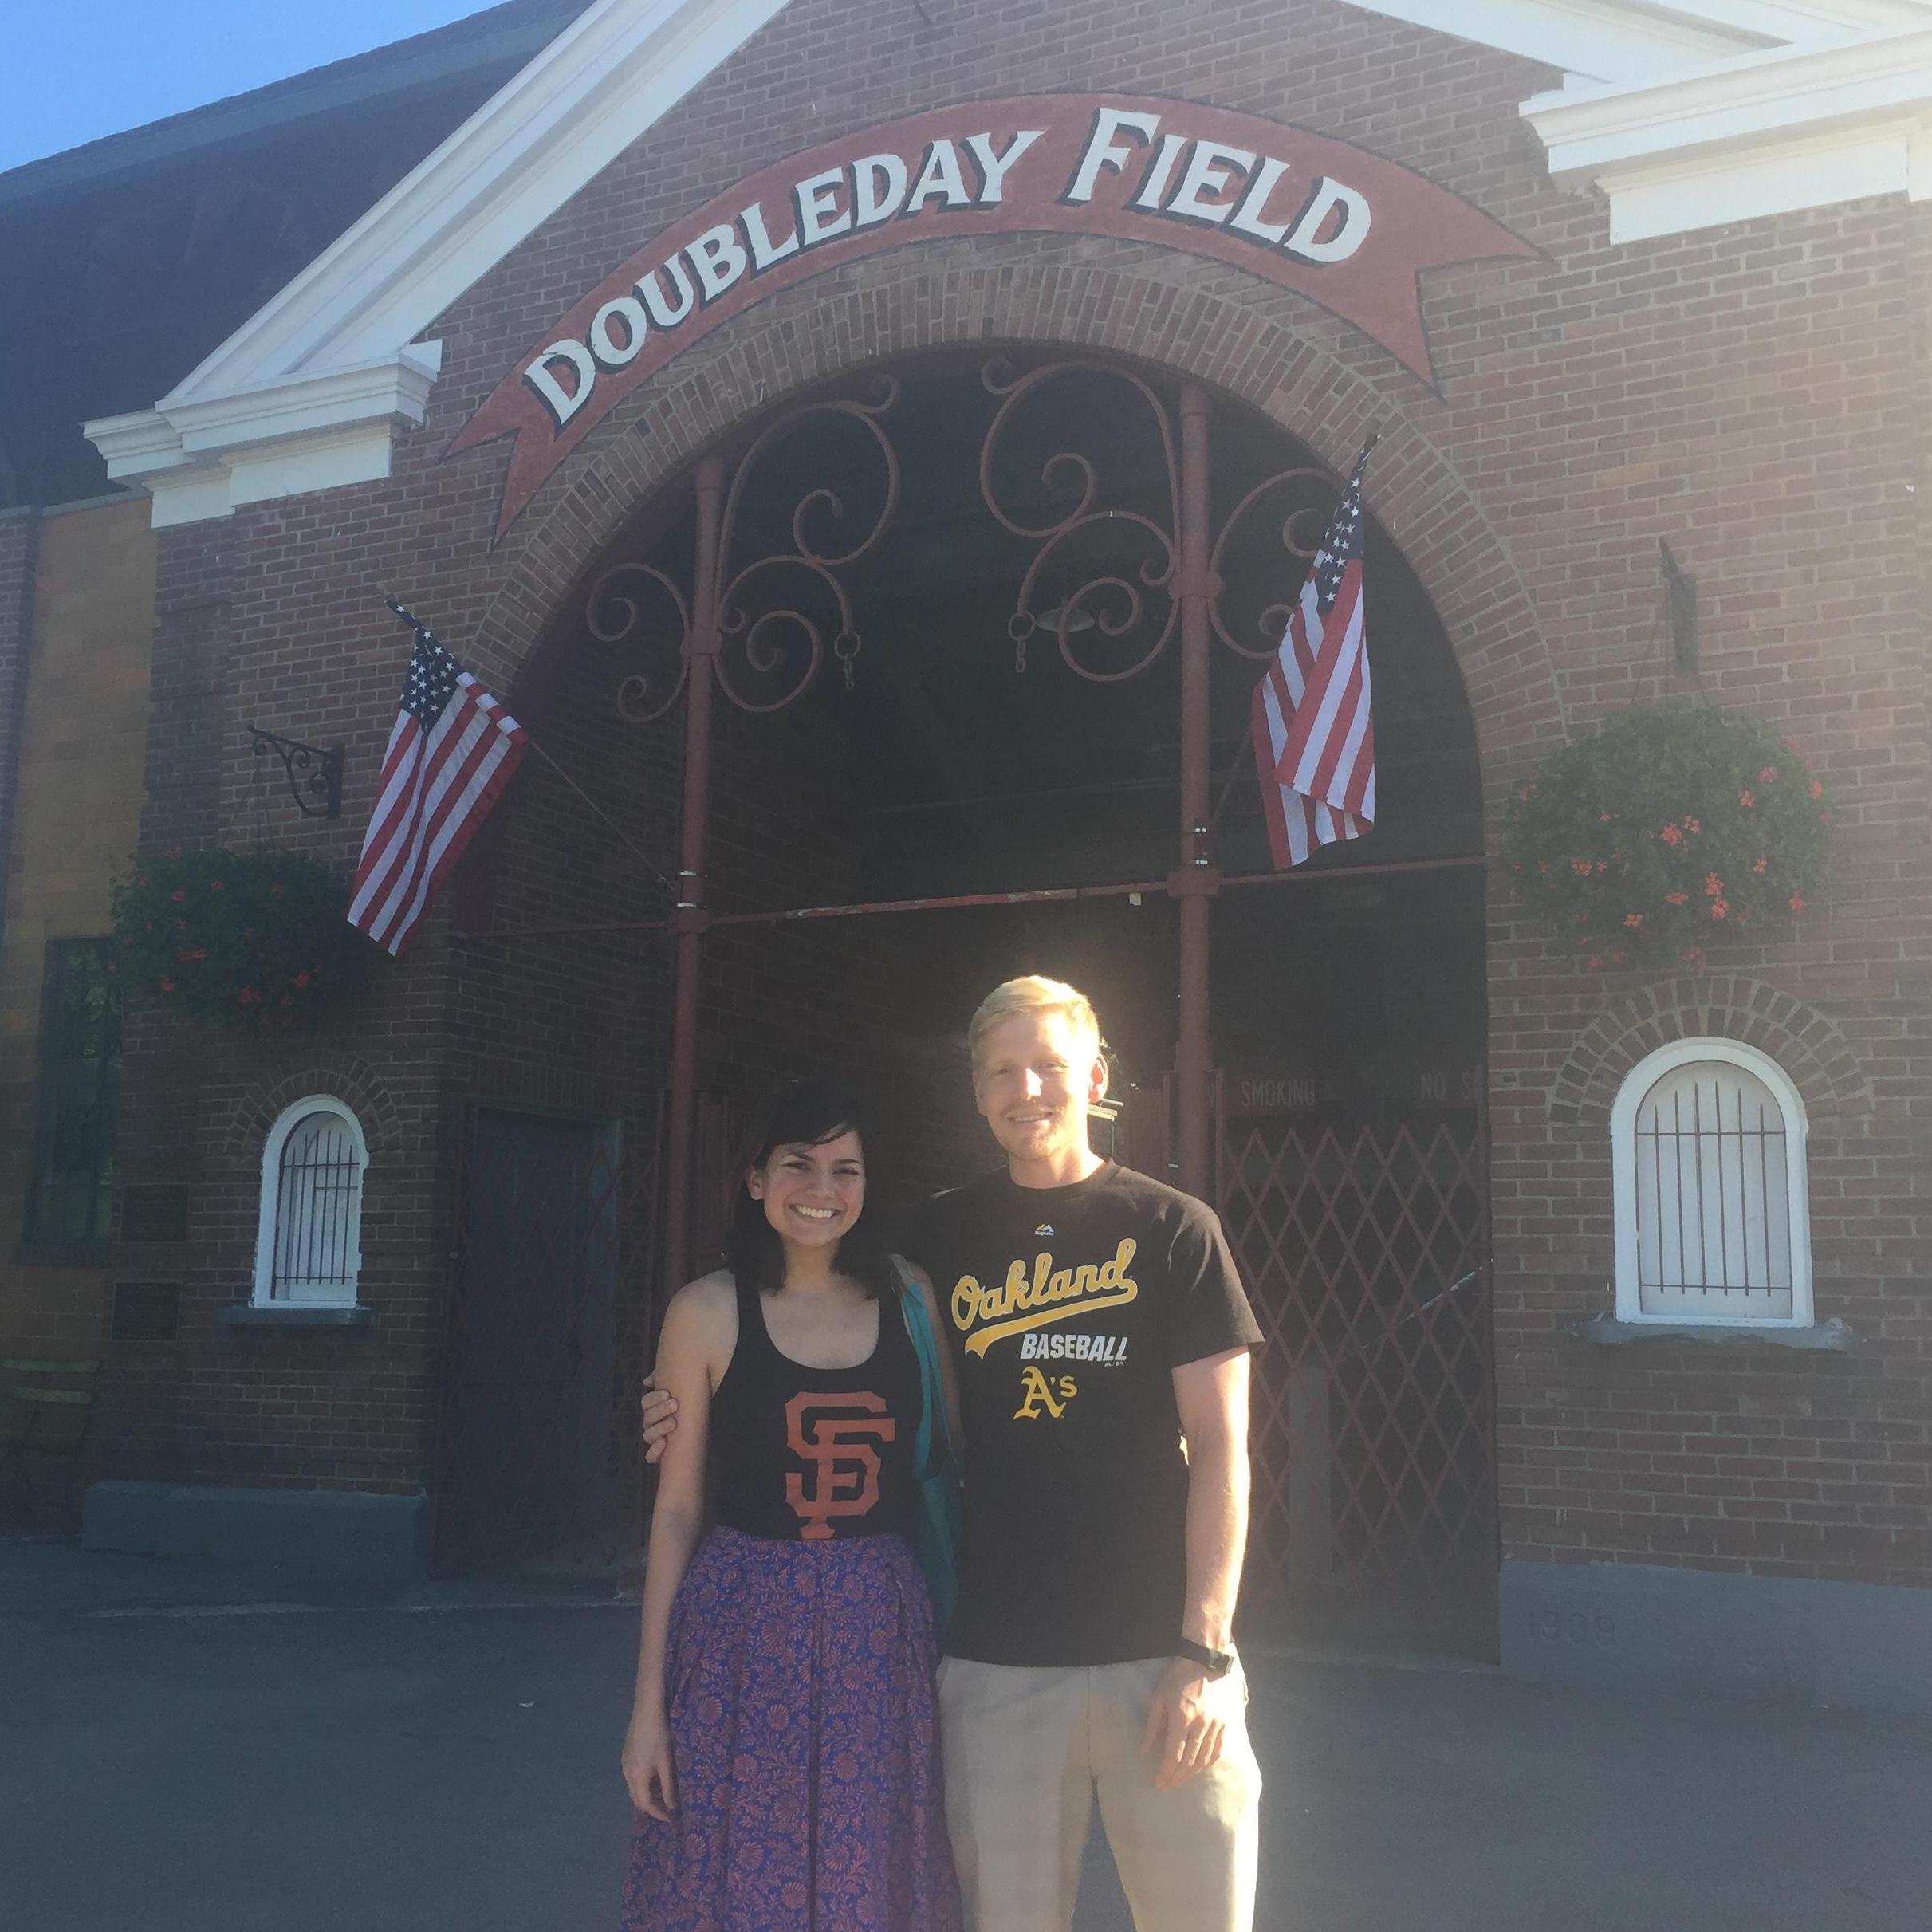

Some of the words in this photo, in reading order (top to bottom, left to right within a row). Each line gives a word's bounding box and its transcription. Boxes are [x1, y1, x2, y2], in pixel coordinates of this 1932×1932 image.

[523, 130, 1045, 426] DOUBLEDAY
[1067, 107, 1372, 263] FIELD
[1240, 1079, 1316, 1108] SMOKING
[1421, 1072, 1446, 1100] NO
[951, 1238, 1138, 1332] Oakland
[1020, 1332, 1128, 1363] BASEBALL
[784, 1390, 896, 1540] SF
